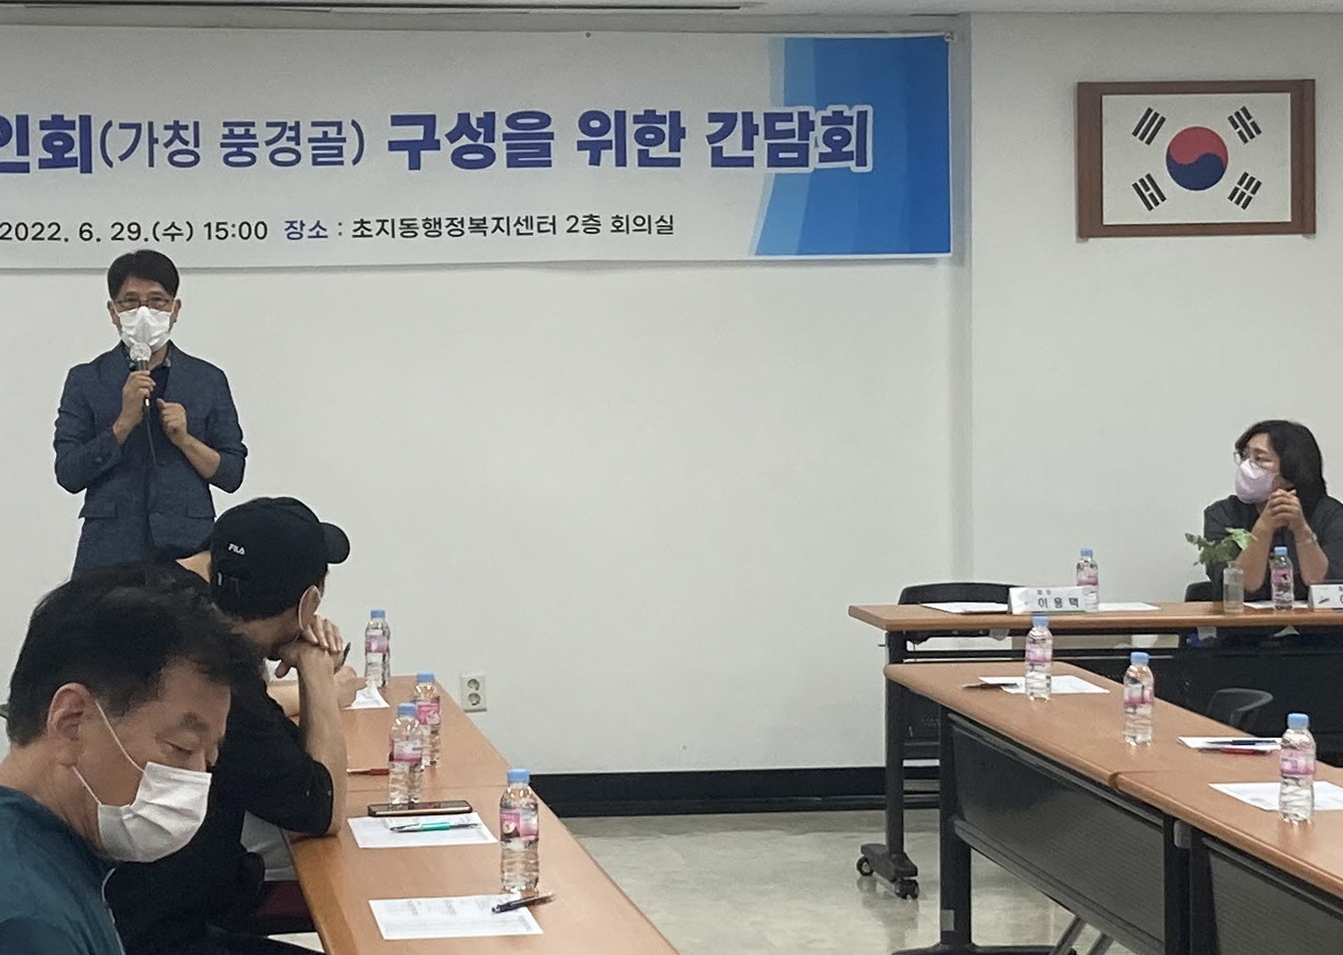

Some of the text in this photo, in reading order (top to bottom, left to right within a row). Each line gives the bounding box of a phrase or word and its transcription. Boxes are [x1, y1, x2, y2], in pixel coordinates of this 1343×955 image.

[219, 119, 365, 167] 풍경골)
[388, 110, 555, 171] 구성을
[576, 109, 686, 168] 위한
[705, 109, 869, 168] 간담회
[79, 221, 101, 242] 6.
[203, 220, 268, 240] 15:00
[284, 219, 329, 239] 장소
[351, 215, 557, 239] 초지동행정복지센터
[566, 214, 602, 234] 2층
[610, 214, 675, 235] 회의실
[228, 543, 246, 555] FILA
